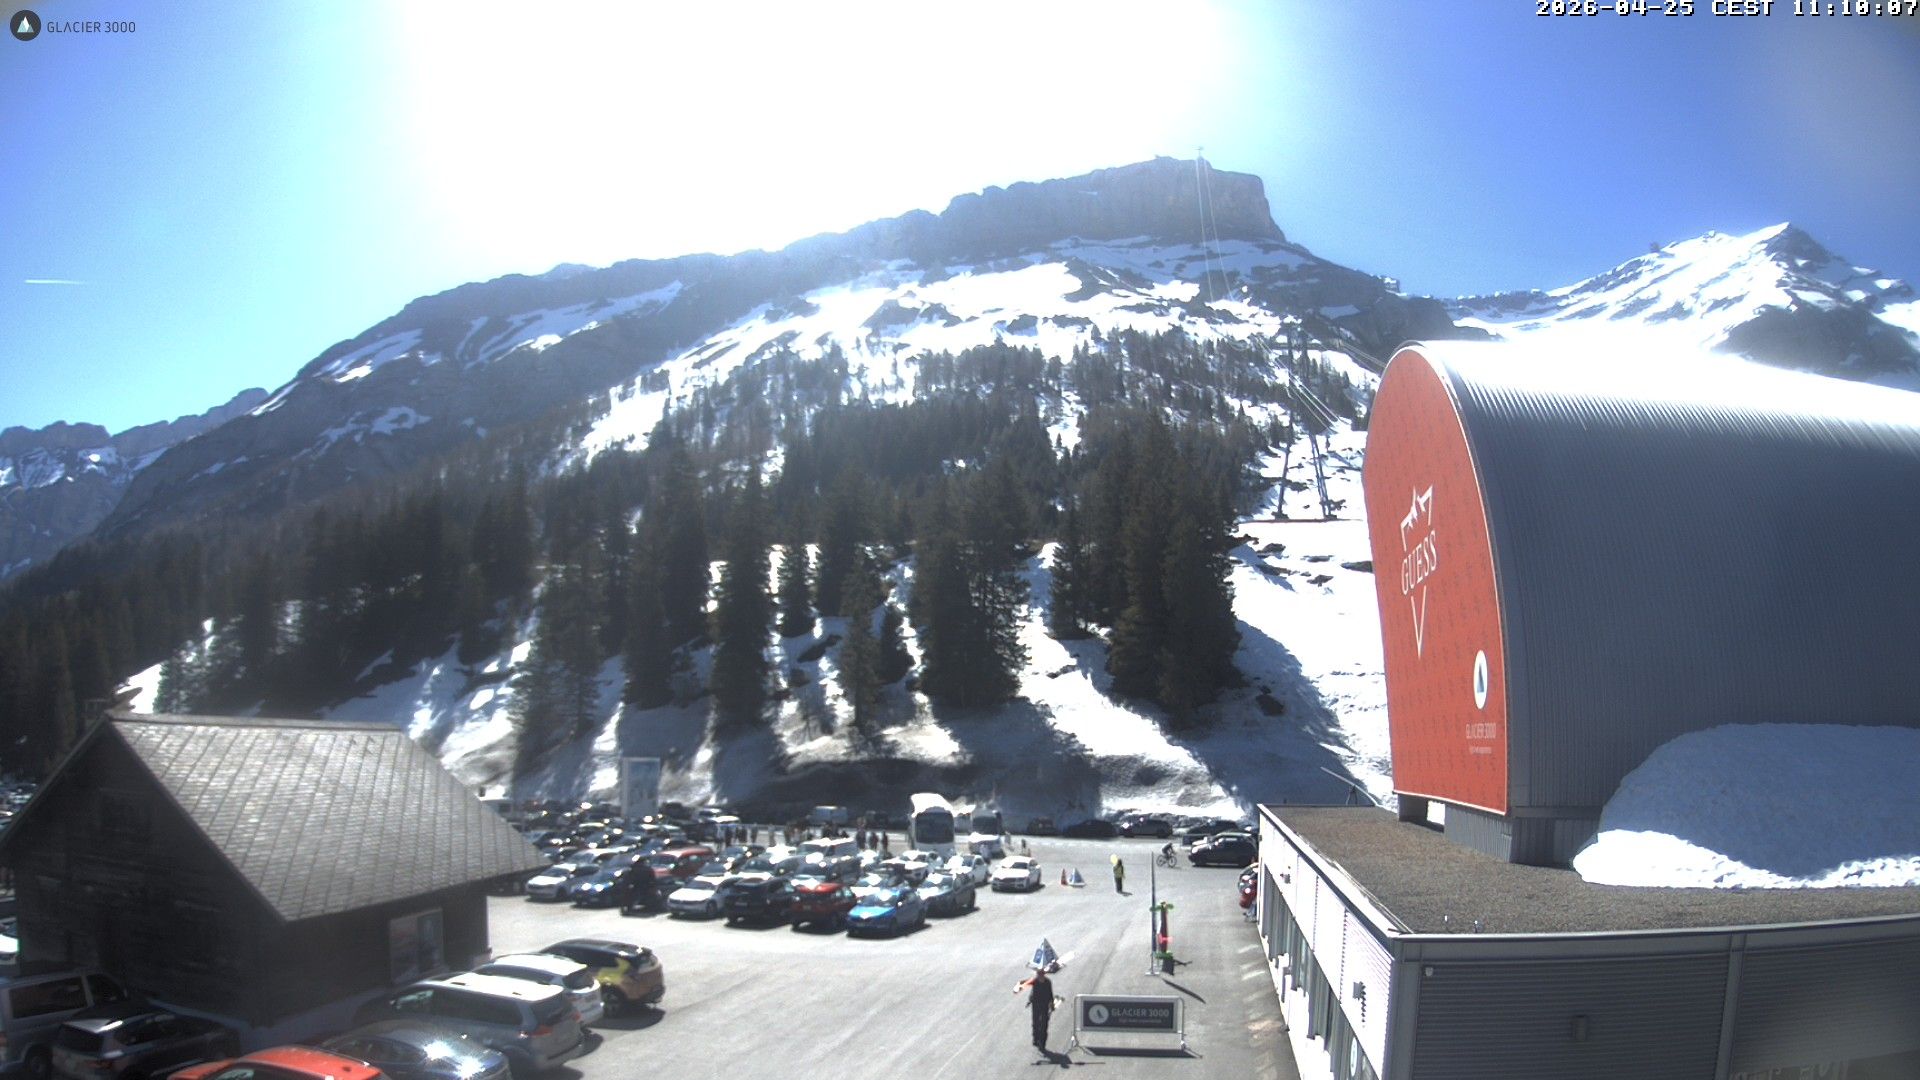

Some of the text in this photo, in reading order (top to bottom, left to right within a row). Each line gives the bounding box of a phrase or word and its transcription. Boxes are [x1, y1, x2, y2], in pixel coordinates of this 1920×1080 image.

[1401, 530, 1437, 595] GUESS
[1111, 1008, 1170, 1018] GLACIER 3000
